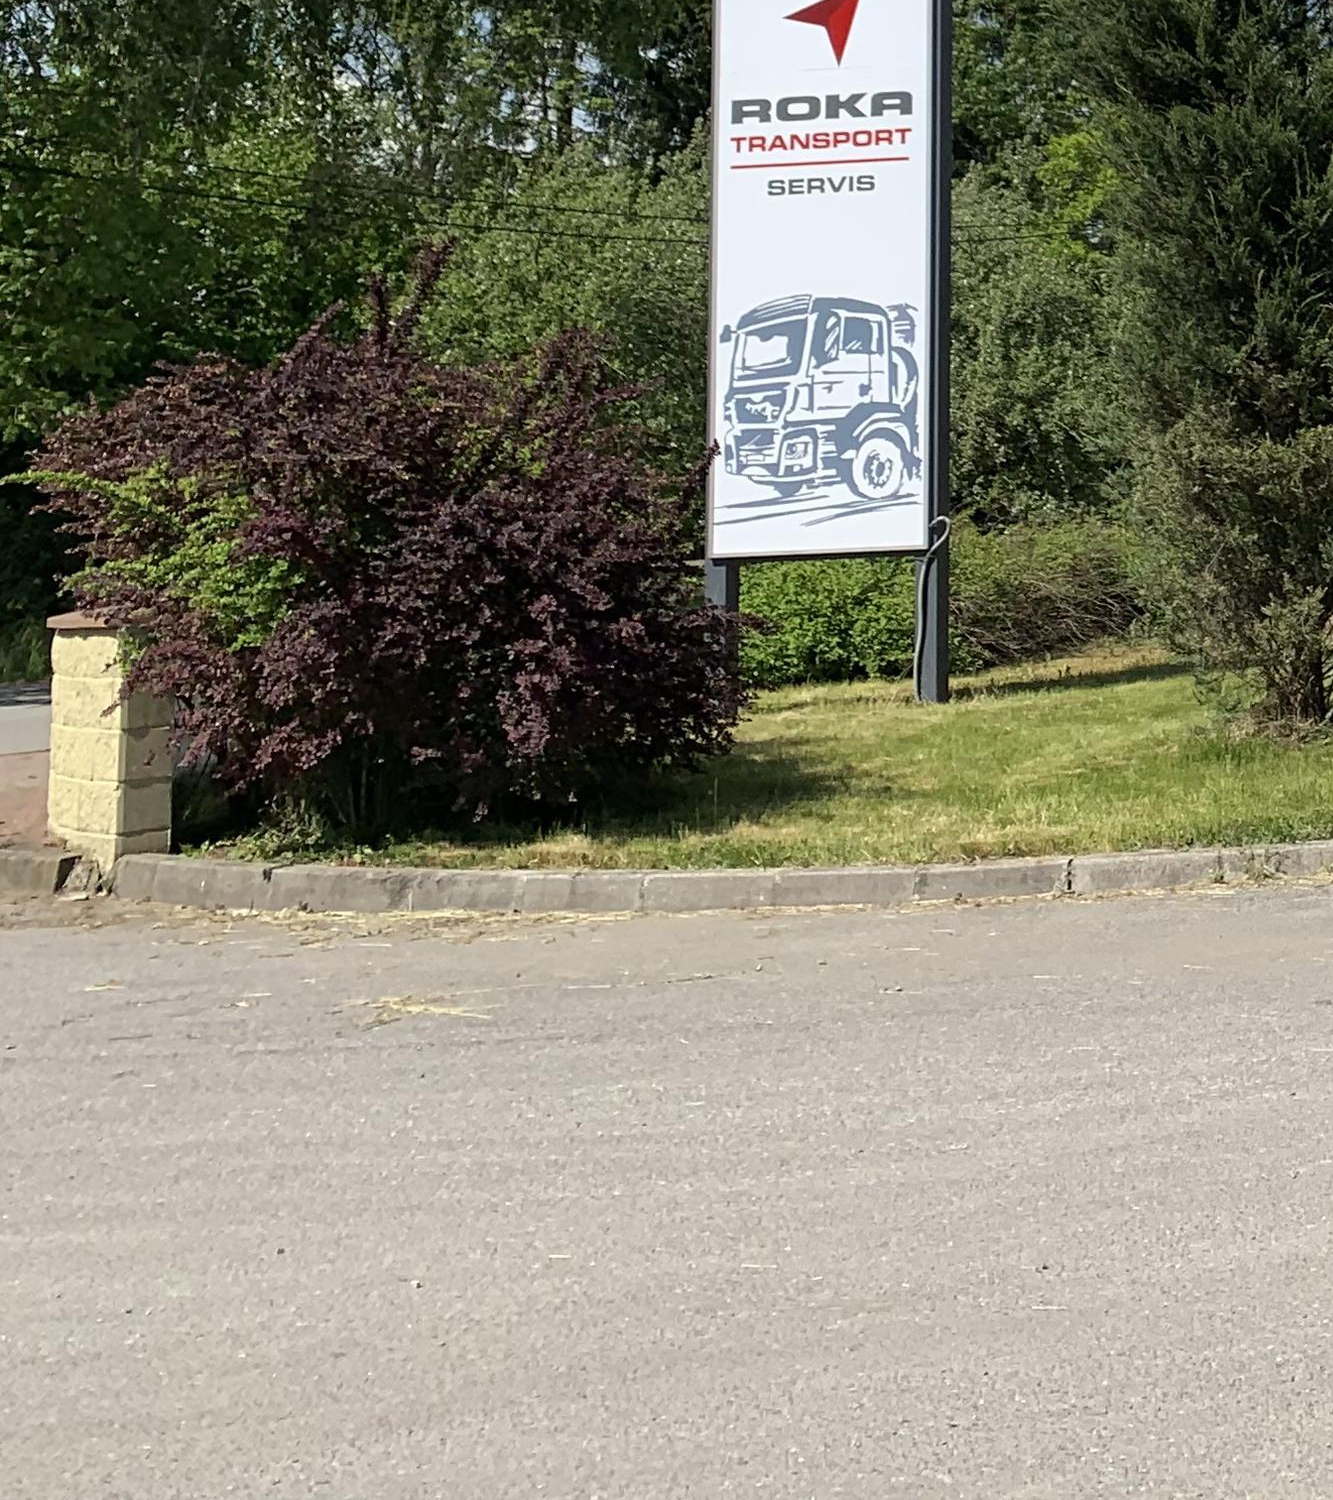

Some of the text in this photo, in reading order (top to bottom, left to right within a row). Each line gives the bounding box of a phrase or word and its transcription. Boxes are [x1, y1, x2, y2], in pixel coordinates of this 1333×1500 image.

[731, 91, 913, 124] ROKA
[730, 128, 912, 153] TRANSPORT
[767, 175, 876, 196] SERVIS
